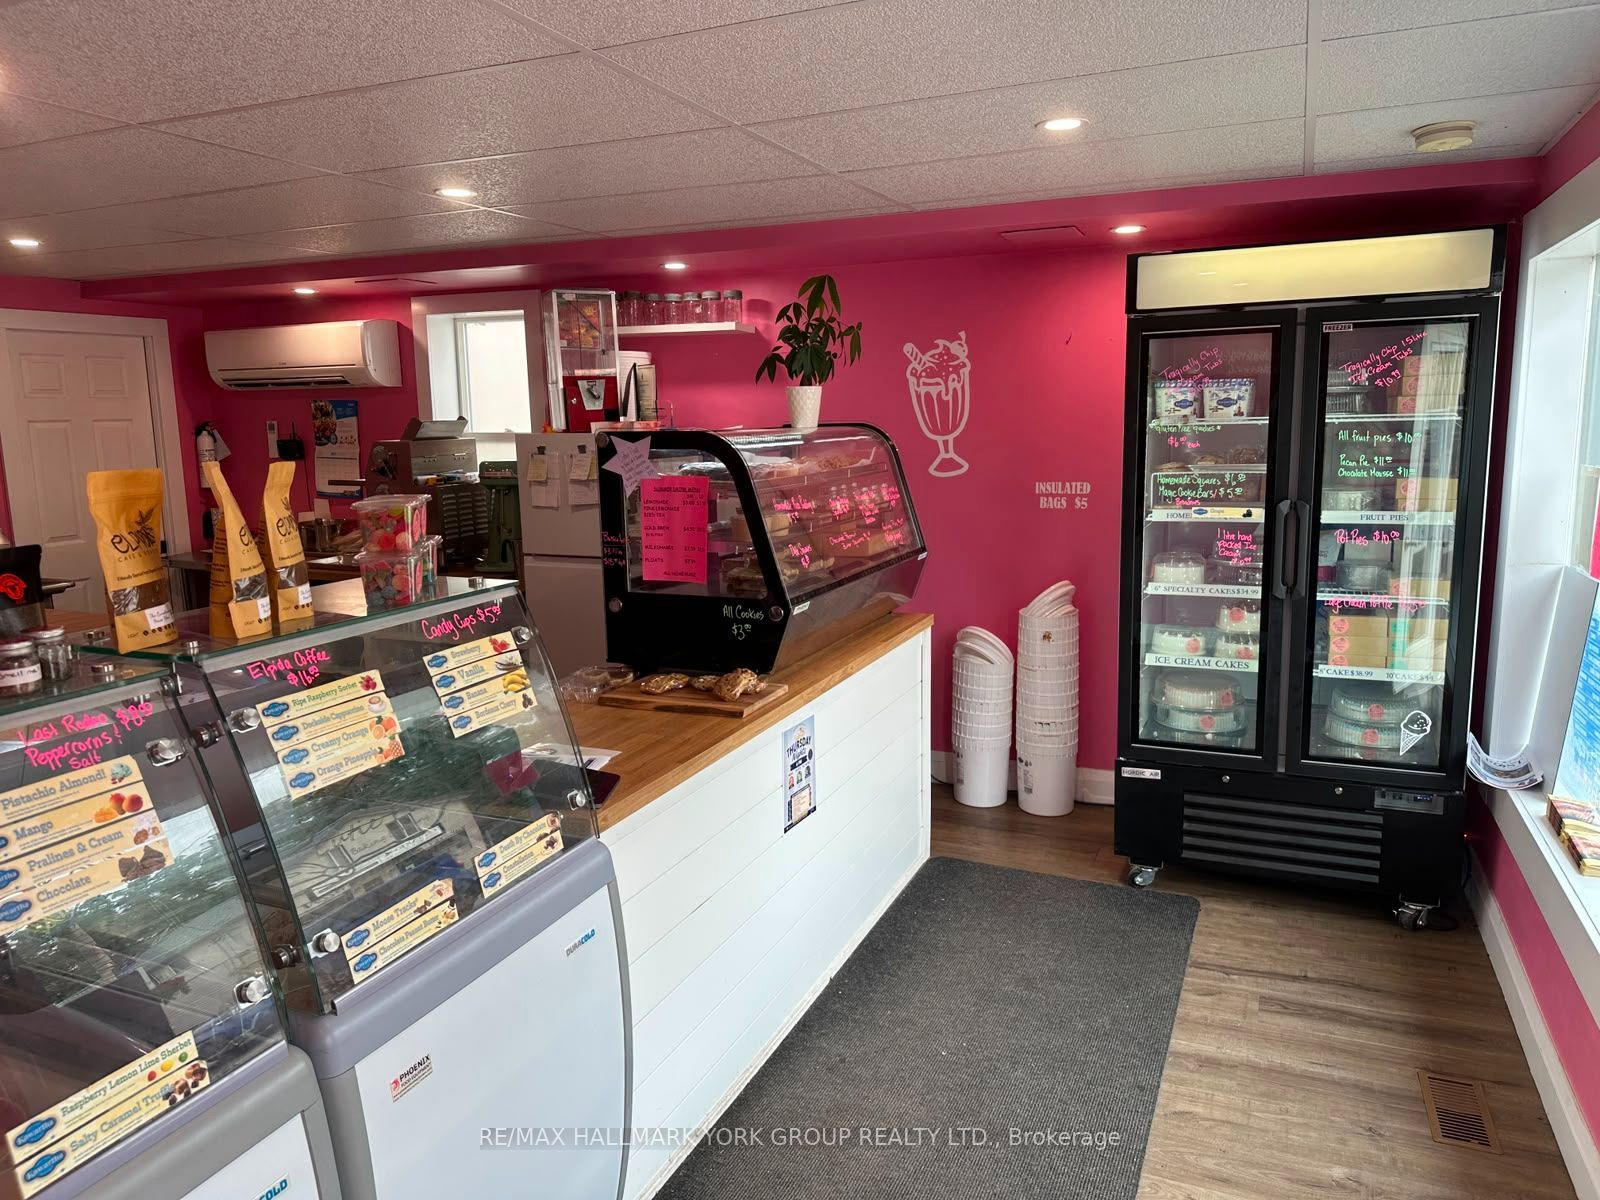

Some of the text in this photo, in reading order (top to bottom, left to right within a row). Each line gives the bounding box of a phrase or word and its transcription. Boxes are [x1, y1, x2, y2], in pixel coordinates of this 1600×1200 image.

[1324, 324, 1353, 332] FREEZER
[1200, 347, 1220, 361] Chip
[1381, 344, 1398, 358] Chip
[1203, 358, 1223, 371] Tubs
[1367, 362, 1393, 376] Cream
[1390, 347, 1413, 362] Tubs
[1338, 430, 1349, 440] All
[1352, 430, 1370, 442] fruit
[1373, 433, 1392, 447] pies
[1339, 453, 1357, 467] Pecan
[1359, 454, 1370, 466] Pie
[1035, 481, 1091, 495] INSULATED
[1190, 473, 1221, 488] Squares
[1040, 496, 1088, 509] BAGS $5
[1360, 513, 1410, 522] FRUIT PIES
[1334, 528, 1350, 544] Pot
[1350, 528, 1369, 546] Pies
[1163, 585, 1206, 594] SPECIALTY
[1209, 586, 1236, 594] CAKES
[722, 604, 765, 621] All Cookies
[421, 618, 460, 641] Candy
[453, 613, 477, 635] Cups
[246, 647, 331, 681] Elpida Coffee
[456, 663, 486, 680] Vanilla
[1154, 656, 1250, 670] ICE CREAM CAKES
[1326, 668, 1350, 676] CAKE
[306, 687, 338, 705] Raspberry
[16, 722, 59, 747] Last
[310, 724, 370, 753] Creamy Orange
[24, 732, 113, 772] Peppercorns
[786, 735, 812, 758] THURSDAY
[69, 753, 102, 770] Salt
[315, 759, 345, 777] Orange
[1, 768, 107, 811] Pistachio Almond
[13, 821, 54, 842] Mango
[26, 829, 125, 873] Pralines & Cream
[36, 875, 93, 903] Chocolate
[372, 914, 396, 932] Moose
[378, 935, 406, 957] Chocolate
[400, 1053, 431, 1082] PHOENIX
[60, 1038, 193, 1119] Raspberry Lemon Lime Sherbet
[69, 1129, 98, 1154] Salty
[99, 1103, 142, 1134] Caramel
